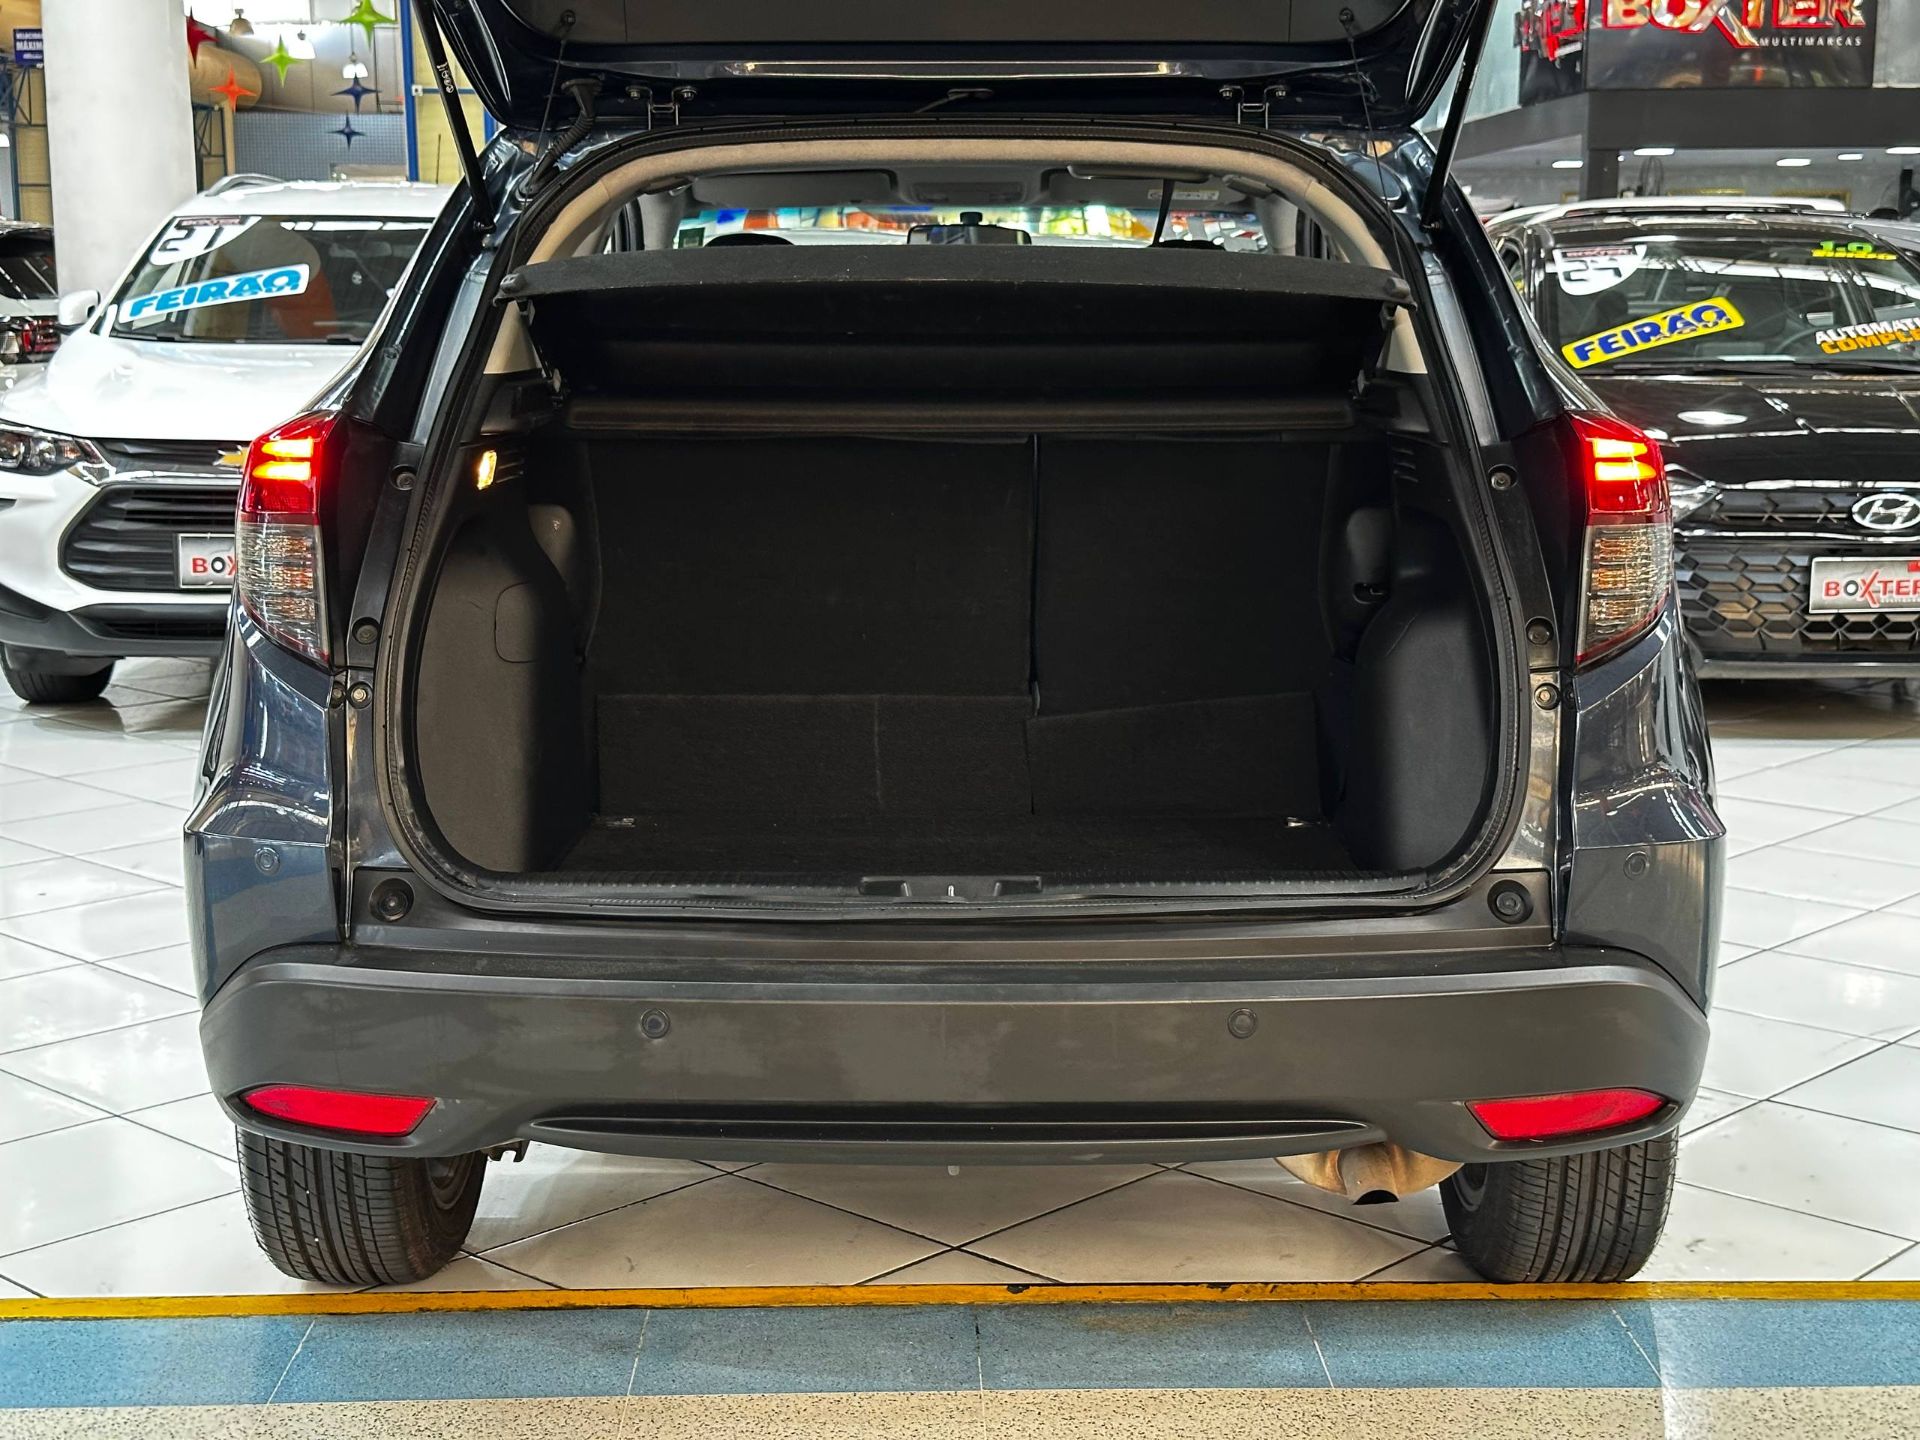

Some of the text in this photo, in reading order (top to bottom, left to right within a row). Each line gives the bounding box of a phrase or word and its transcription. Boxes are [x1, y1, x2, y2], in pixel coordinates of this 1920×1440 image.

[1759, 36, 1862, 47] MULTIMARCAS
[129, 269, 302, 318] FEIRÃO
[1573, 304, 1732, 362] FEIRÃO
